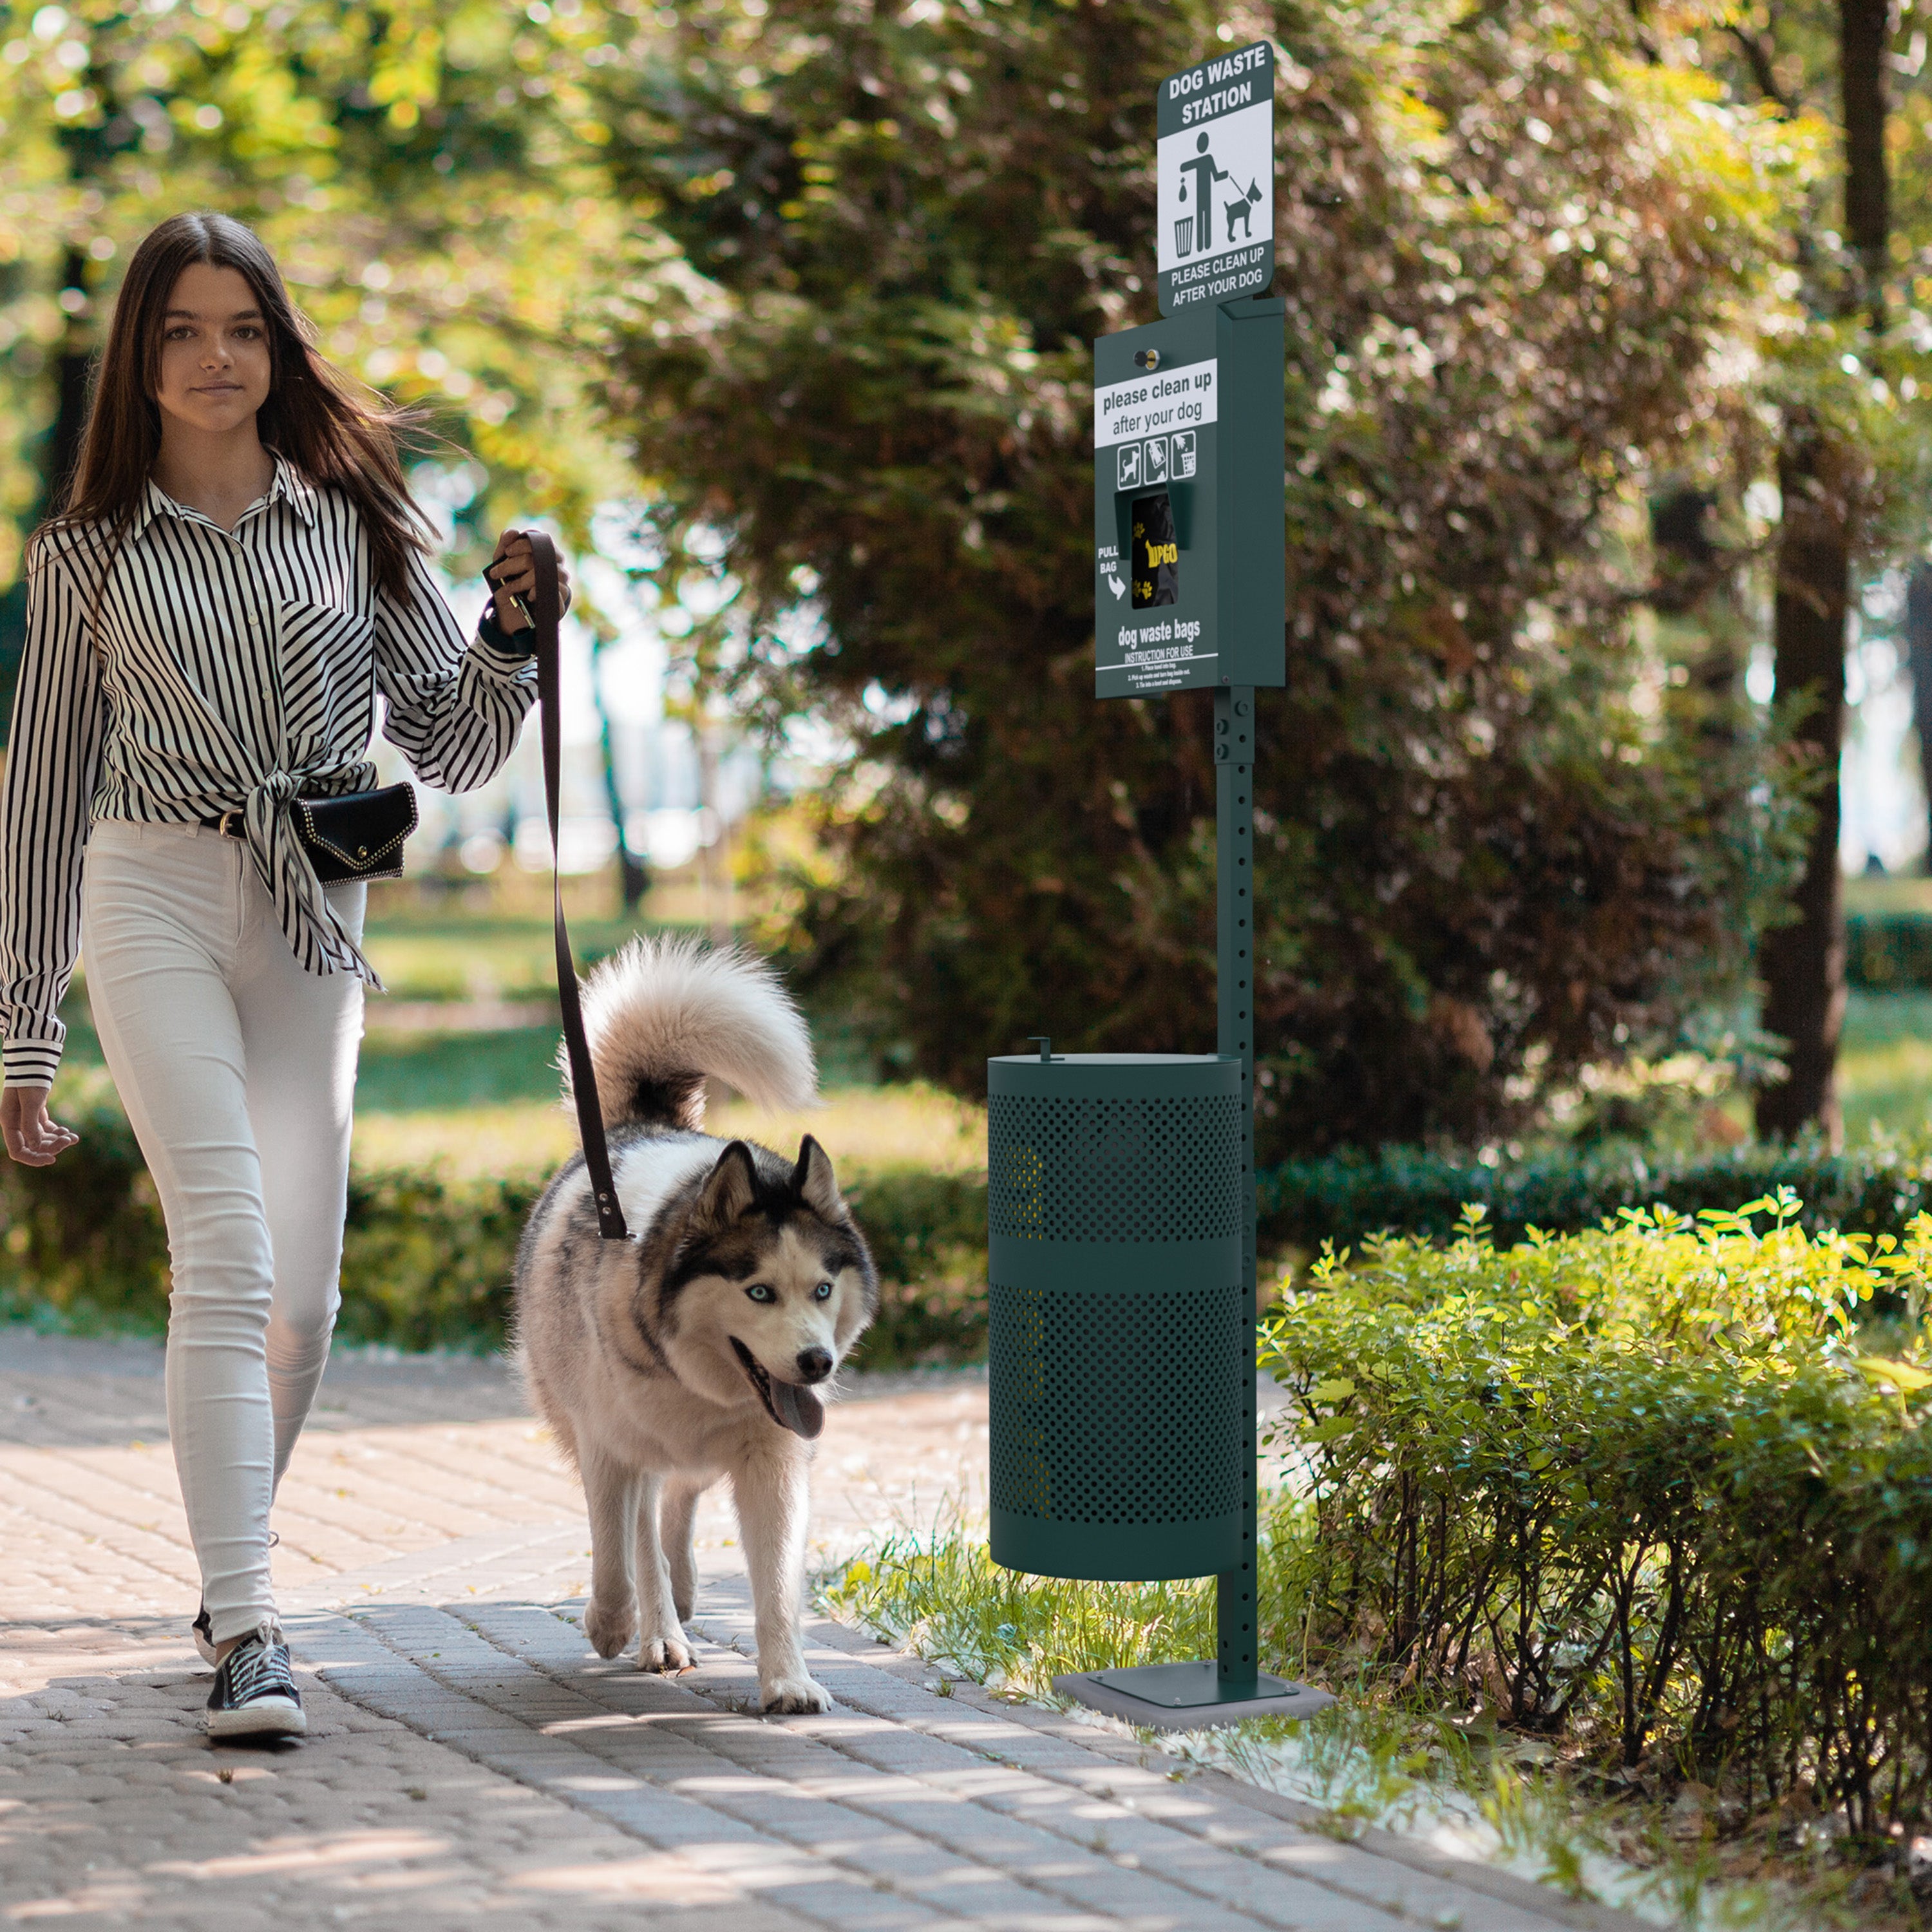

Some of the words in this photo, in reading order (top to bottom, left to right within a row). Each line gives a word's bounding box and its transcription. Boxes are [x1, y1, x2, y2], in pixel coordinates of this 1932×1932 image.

[1170, 70, 1203, 100] DOG
[1208, 45, 1265, 84] WASTE
[1182, 81, 1251, 124] STATION
[1171, 262, 1210, 286] PLEASE
[1213, 252, 1247, 274] CLEAN
[1250, 247, 1264, 263] UP
[1173, 285, 1206, 307] AFTER
[1208, 276, 1236, 296] YOUR
[1239, 269, 1262, 288] DOG
[1104, 388, 1148, 415] please
[1152, 378, 1189, 399] clean
[1195, 372, 1211, 392] up
[1113, 415, 1141, 435] after
[1145, 408, 1173, 433] your
[1178, 401, 1202, 421] dog
[1098, 545, 1119, 558] PULL
[1100, 561, 1117, 574] BAG
[1118, 625, 1137, 650] dog
[1139, 621, 1171, 643] waste
[1174, 618, 1200, 643] bags
[1124, 649, 1166, 664] INSTRUCTION
[1166, 647, 1179, 659] FOR
[1180, 645, 1193, 657] USE
